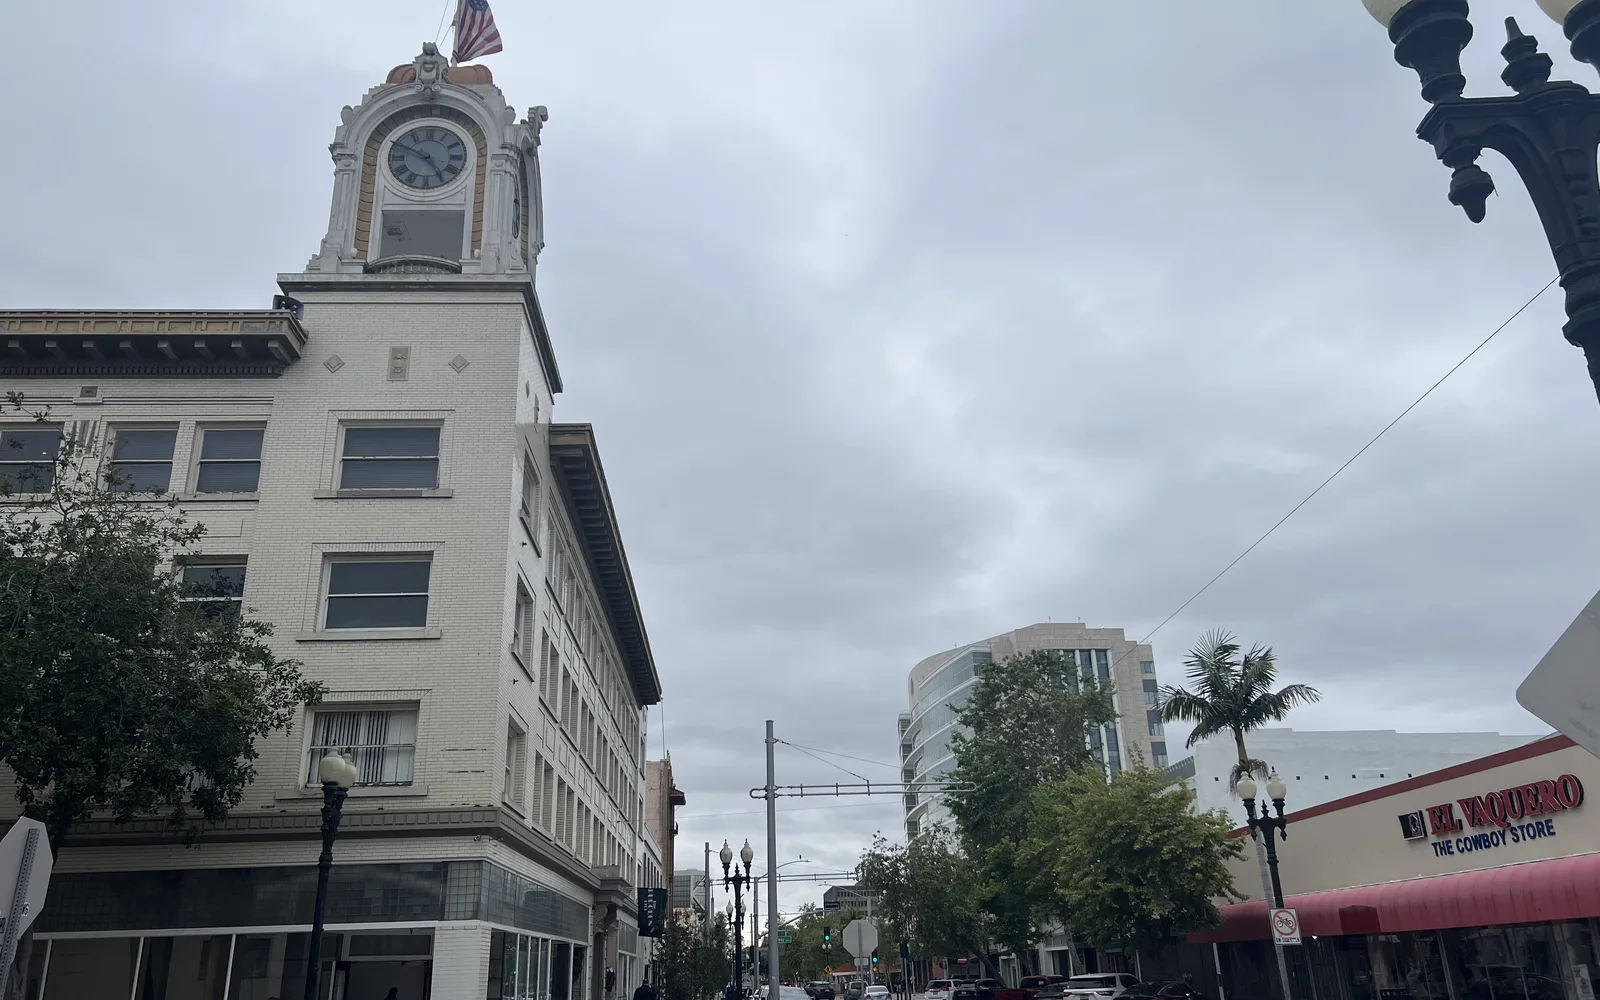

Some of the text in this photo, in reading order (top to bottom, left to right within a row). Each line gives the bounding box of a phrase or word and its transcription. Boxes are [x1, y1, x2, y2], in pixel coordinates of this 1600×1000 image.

[1425, 774, 1584, 835] EL VAQUERO
[1431, 819, 1556, 857] THE COWBOY STORE
